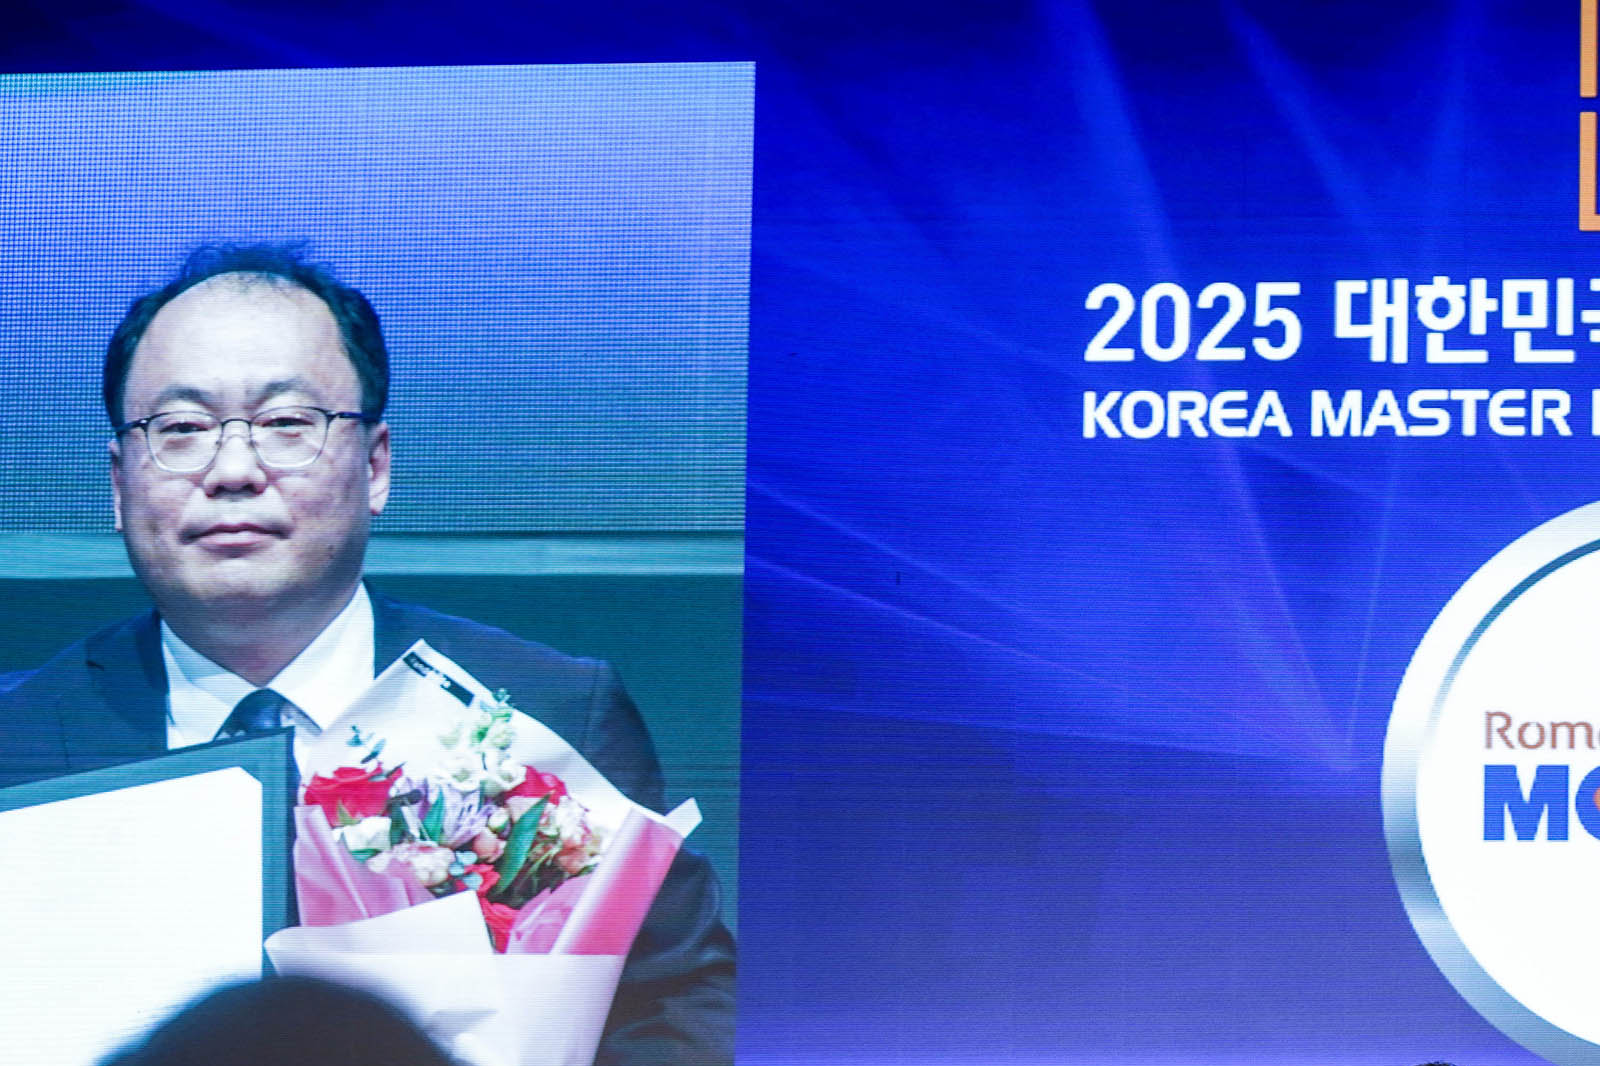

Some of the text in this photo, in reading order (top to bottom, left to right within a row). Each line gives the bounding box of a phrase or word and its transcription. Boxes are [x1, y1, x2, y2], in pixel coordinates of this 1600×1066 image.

[1084, 281, 1302, 362] 2025
[1083, 388, 1293, 438] KOREA
[1311, 388, 1573, 437] MASTER
